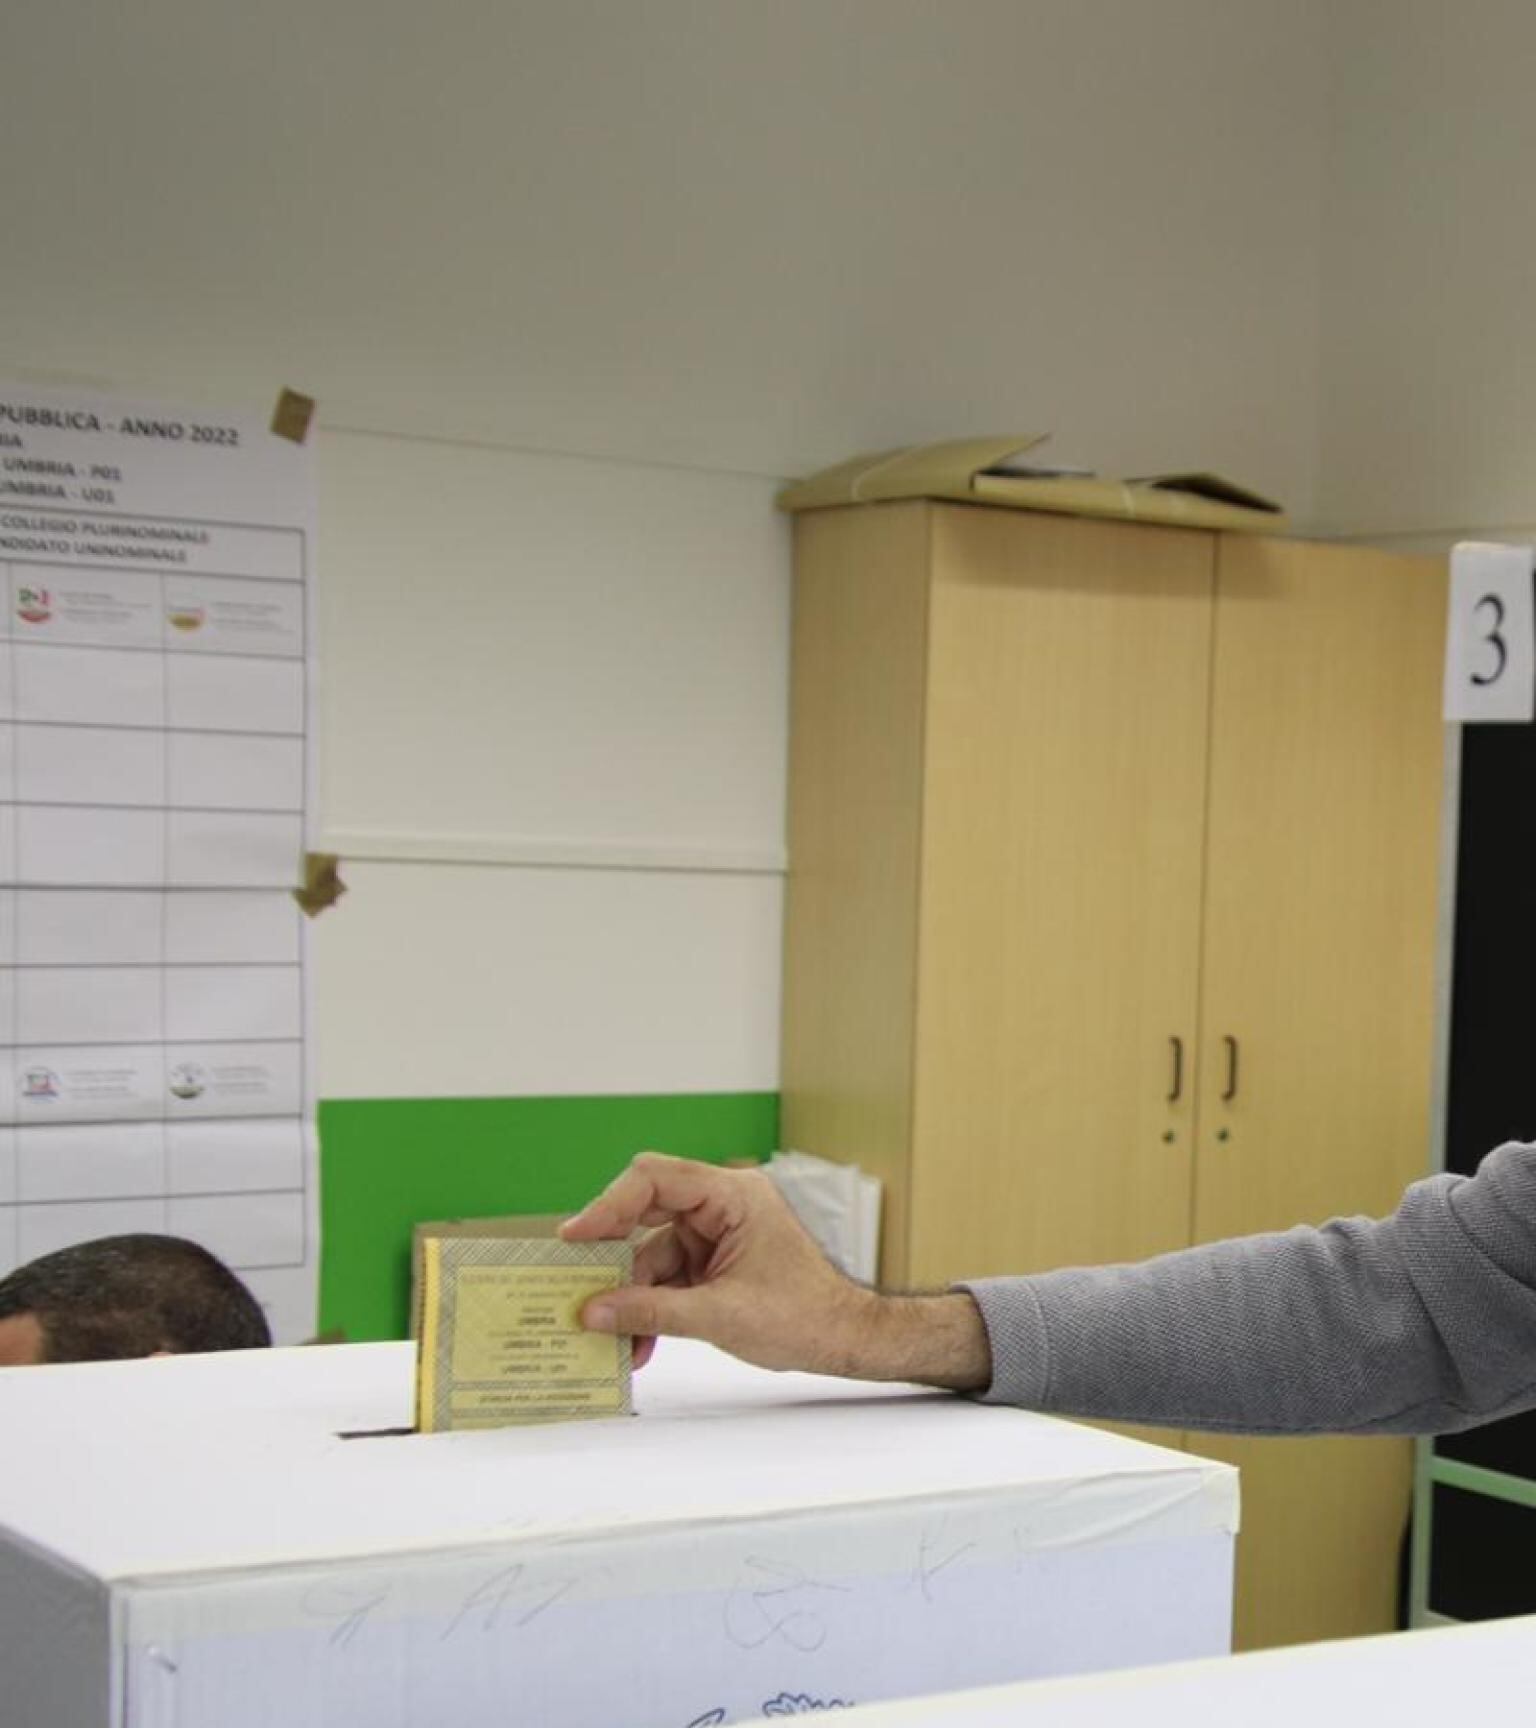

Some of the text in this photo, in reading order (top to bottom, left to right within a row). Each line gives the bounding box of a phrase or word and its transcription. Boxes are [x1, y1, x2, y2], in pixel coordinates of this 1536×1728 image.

[120, 417, 183, 441] ANNO
[191, 423, 239, 447] 2022
[3, 456, 76, 478] UMBRIA
[81, 487, 115, 504] U01
[1, 514, 210, 545] COLLEGIO PLURINOMINALE
[74, 539, 187, 564] UNINOMINALE
[1471, 593, 1507, 686] 3
